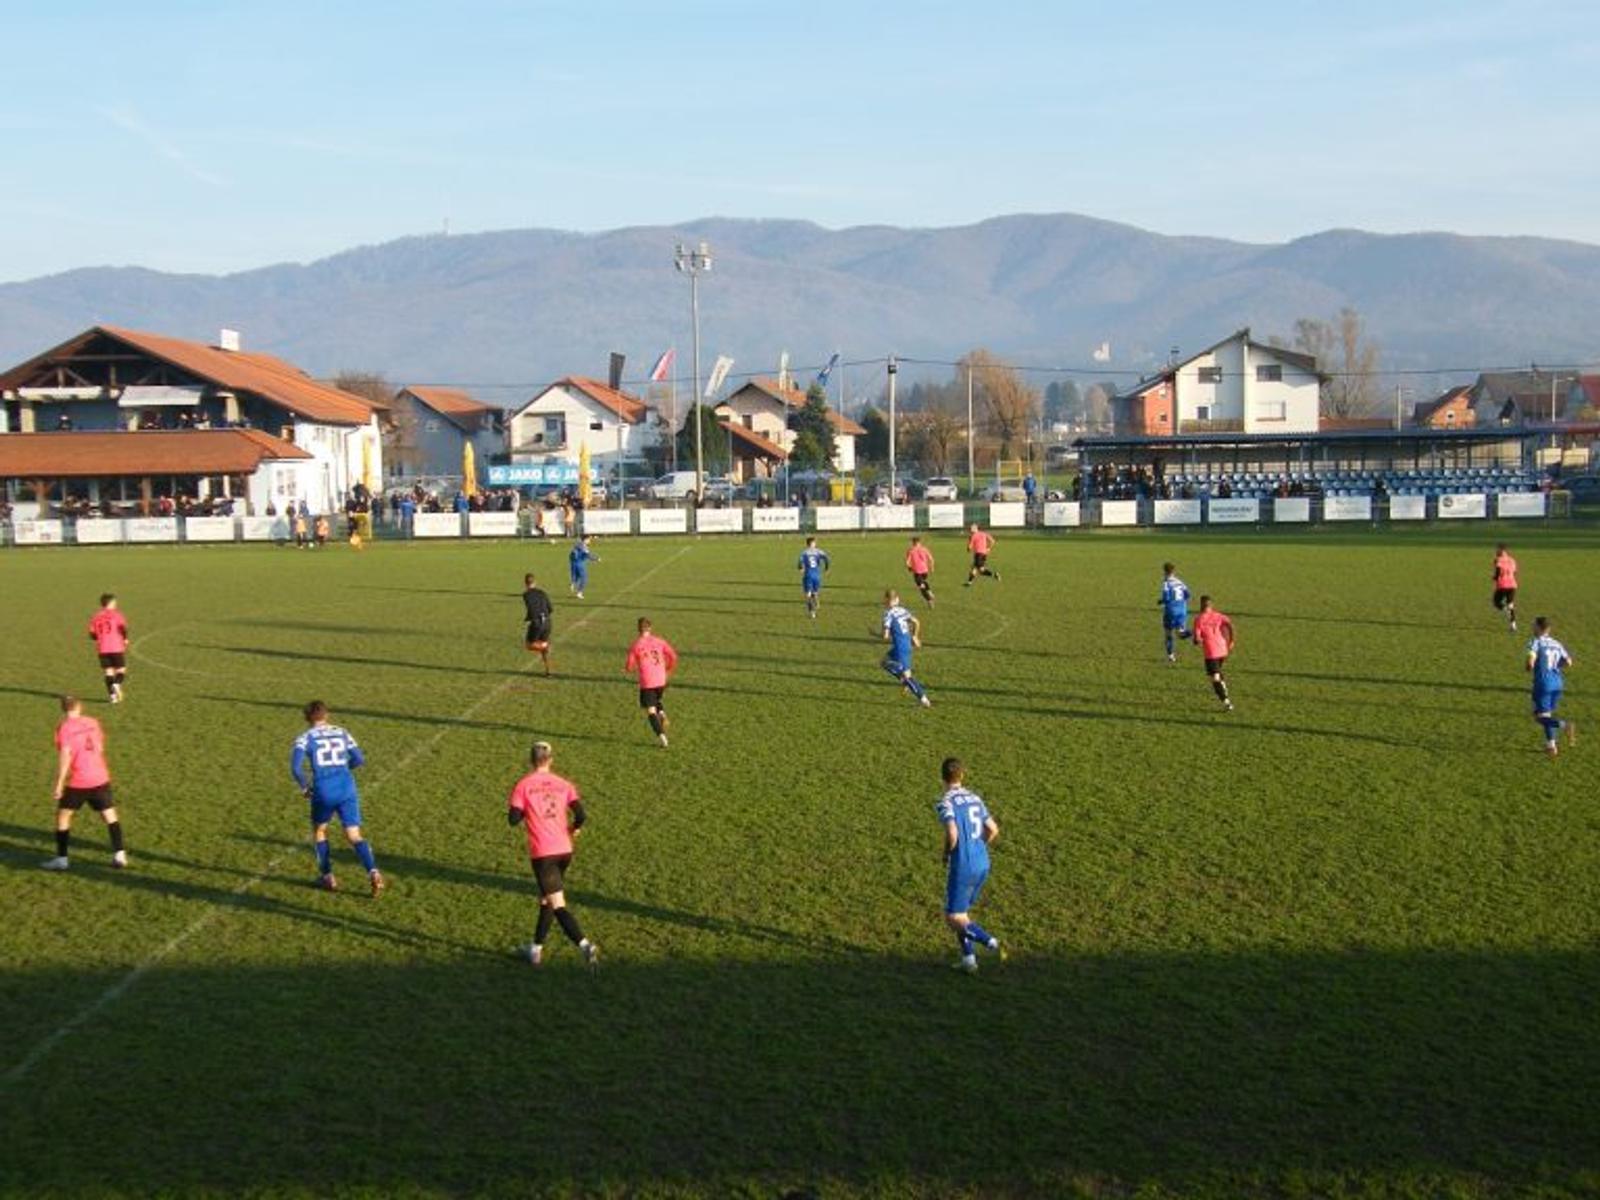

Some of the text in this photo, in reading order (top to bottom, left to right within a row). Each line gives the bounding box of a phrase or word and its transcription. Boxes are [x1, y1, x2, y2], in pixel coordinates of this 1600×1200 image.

[508, 467, 598, 480] JAKO JAO
[315, 738, 348, 767] 22
[968, 805, 982, 840] 5
